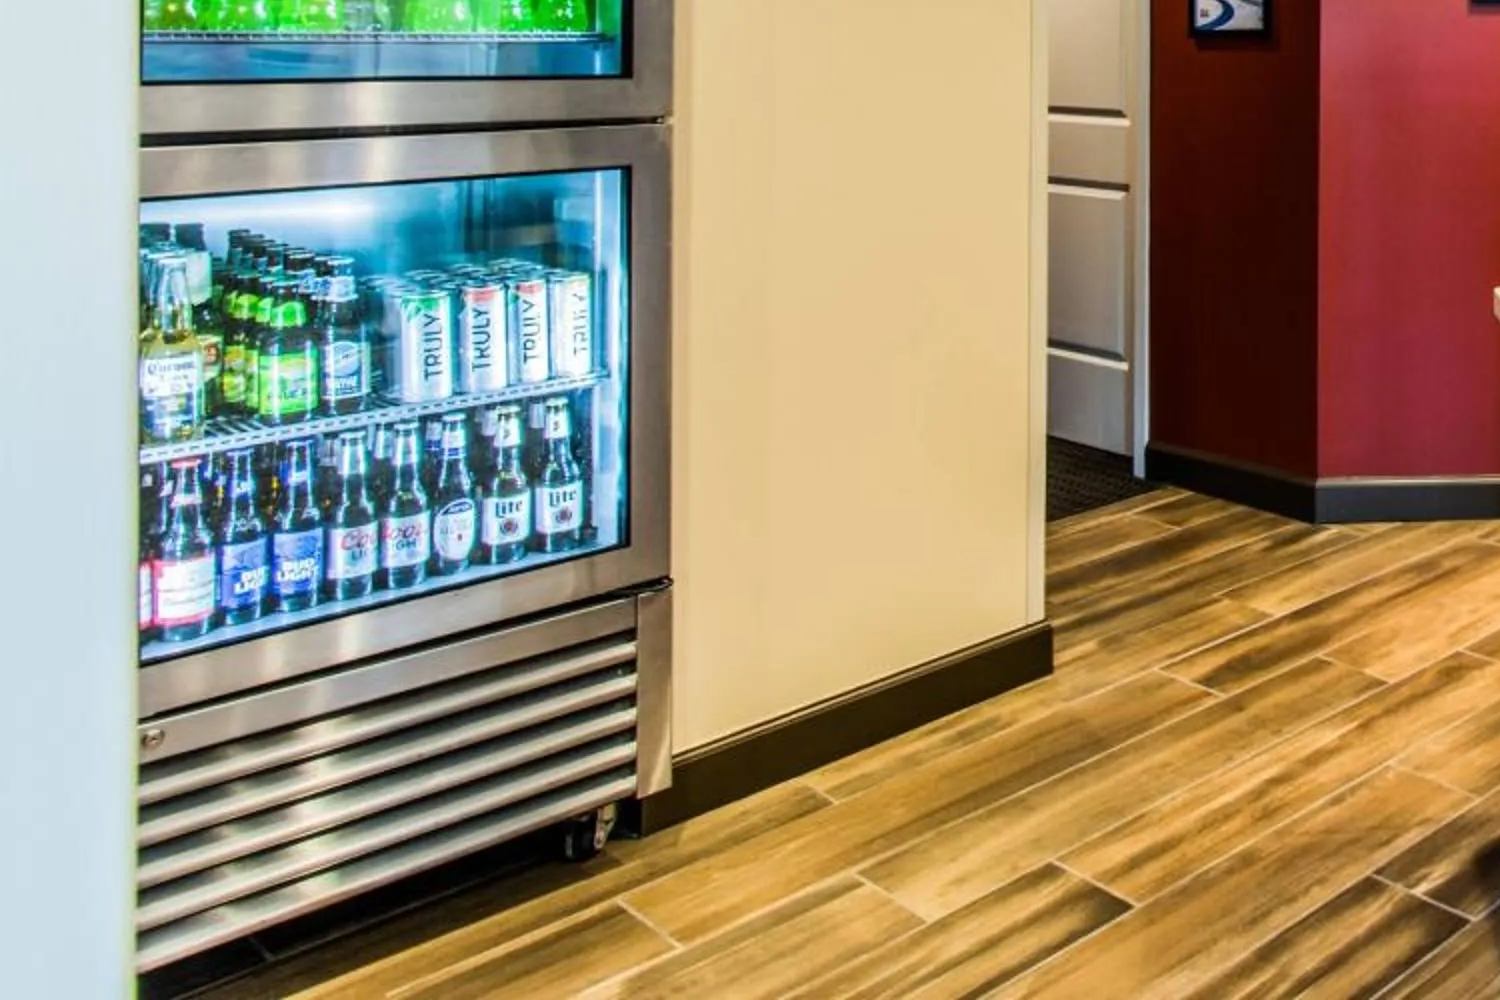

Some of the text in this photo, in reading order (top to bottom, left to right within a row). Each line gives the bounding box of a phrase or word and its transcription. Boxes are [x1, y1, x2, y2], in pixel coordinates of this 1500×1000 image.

[424, 312, 444, 384] TRULY
[472, 307, 492, 372] TRULY
[522, 298, 542, 365] TRULY
